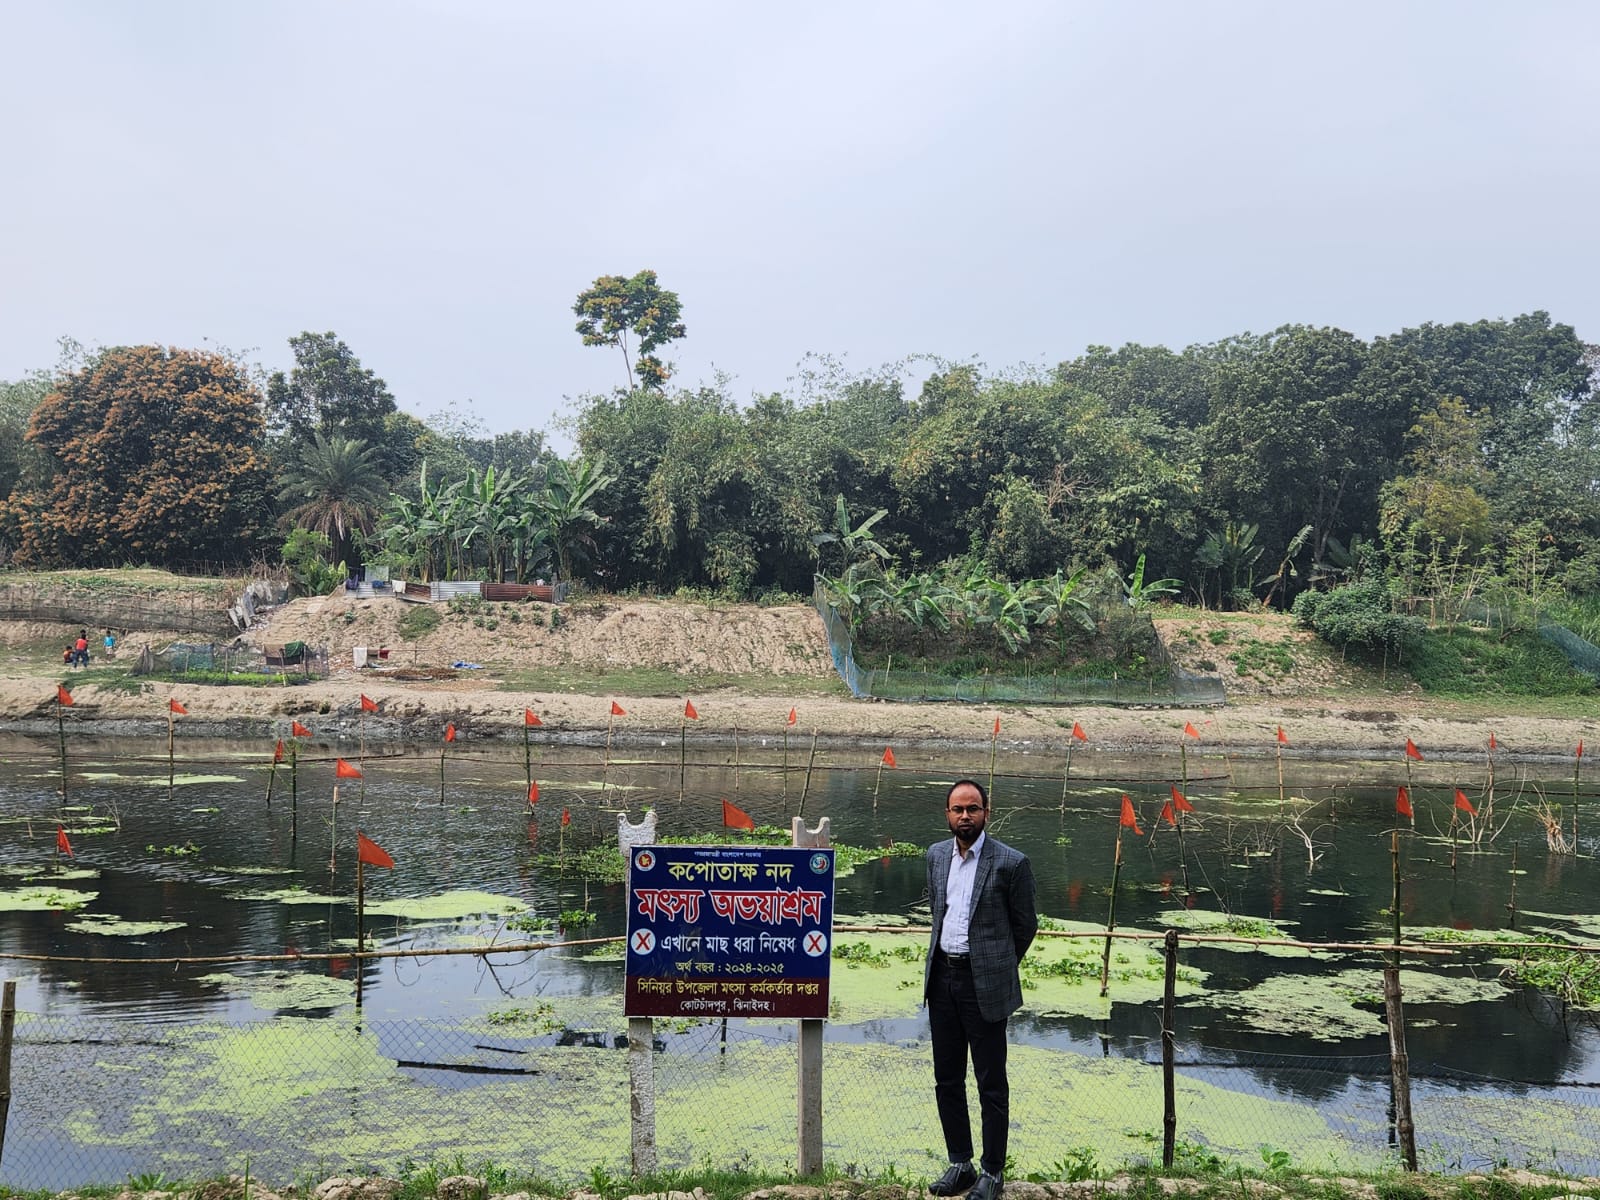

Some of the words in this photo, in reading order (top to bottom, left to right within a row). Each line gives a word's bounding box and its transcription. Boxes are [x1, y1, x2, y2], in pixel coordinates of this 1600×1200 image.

[667, 861, 759, 884] কপোতাক্ষ
[764, 862, 794, 884] নদ
[634, 888, 705, 924] মৎস্য
[709, 886, 826, 927] অভয়াশ্রম
[661, 934, 701, 953] এখানে
[705, 936, 730, 955] মাছ
[734, 936, 755, 954] ধরা
[759, 932, 796, 953] নিষেধ
[675, 959, 692, 973] অর্থ
[695, 962, 715, 973] বছর
[725, 962, 785, 974] ২০২৪-২০২৫
[637, 979, 672, 996] সিনিয়র
[675, 980, 717, 995] উপজেলা
[721, 982, 745, 996] মৎস্য
[749, 979, 793, 995] কর্মকর্তার
[797, 982, 819, 995] দপ্তর
